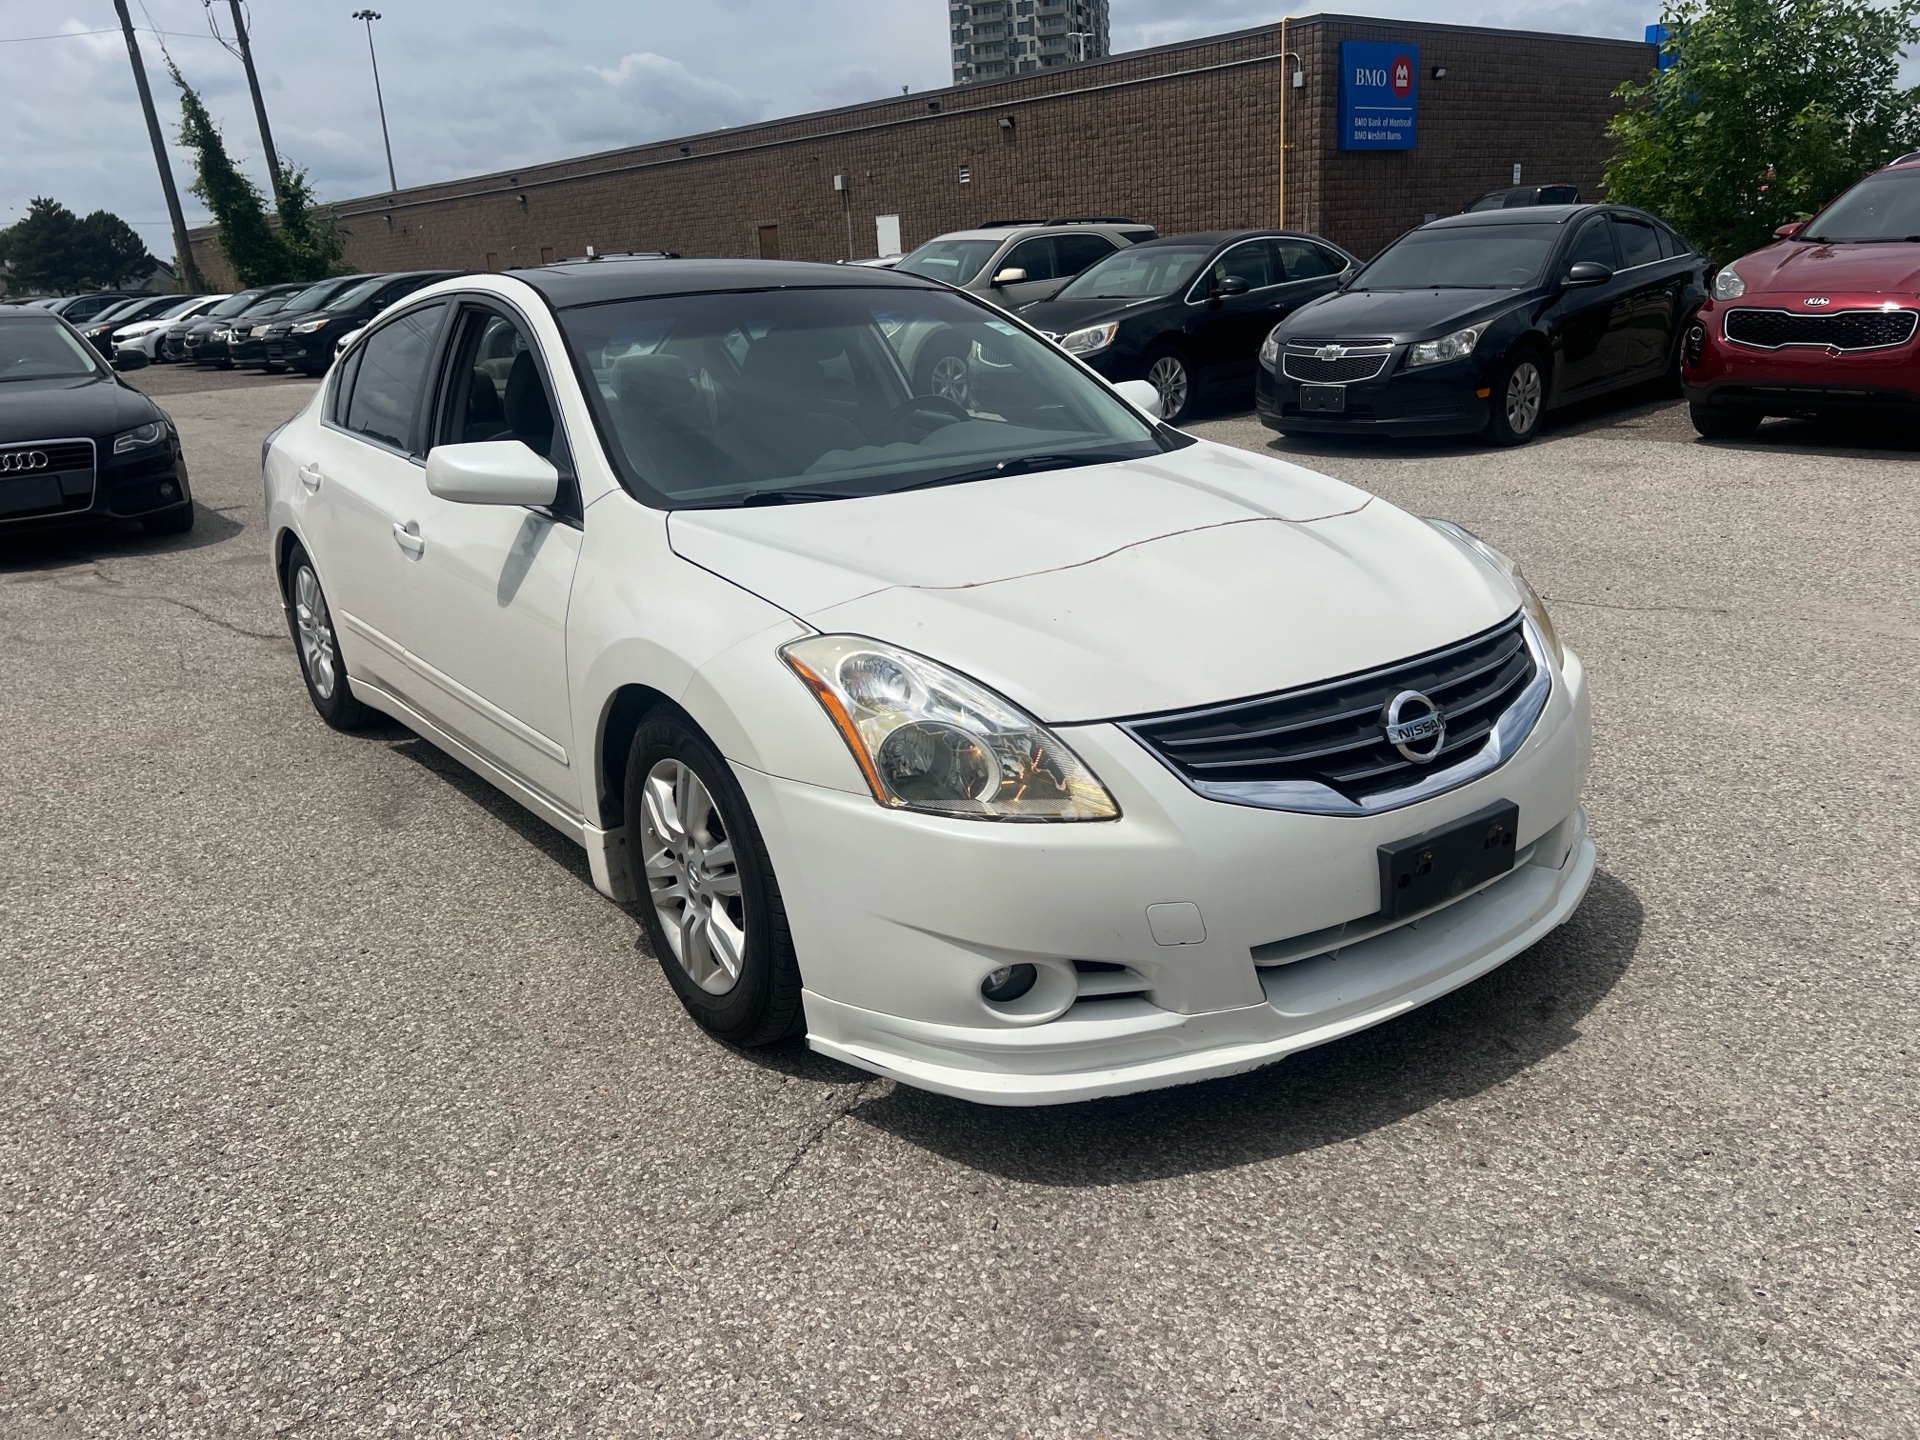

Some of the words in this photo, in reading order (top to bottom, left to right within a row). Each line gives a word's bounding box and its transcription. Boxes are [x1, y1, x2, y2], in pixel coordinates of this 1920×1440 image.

[1355, 68, 1387, 87] BMO
[1354, 117, 1368, 127] BMO
[1368, 117, 1382, 127] Bank
[1382, 117, 1389, 127] of
[1389, 117, 1412, 127] Montreal
[1354, 131, 1367, 140] BMO
[1367, 131, 1387, 140] Nesbitt
[1387, 131, 1402, 140] Burns
[1398, 718, 1444, 739] NISSAN
